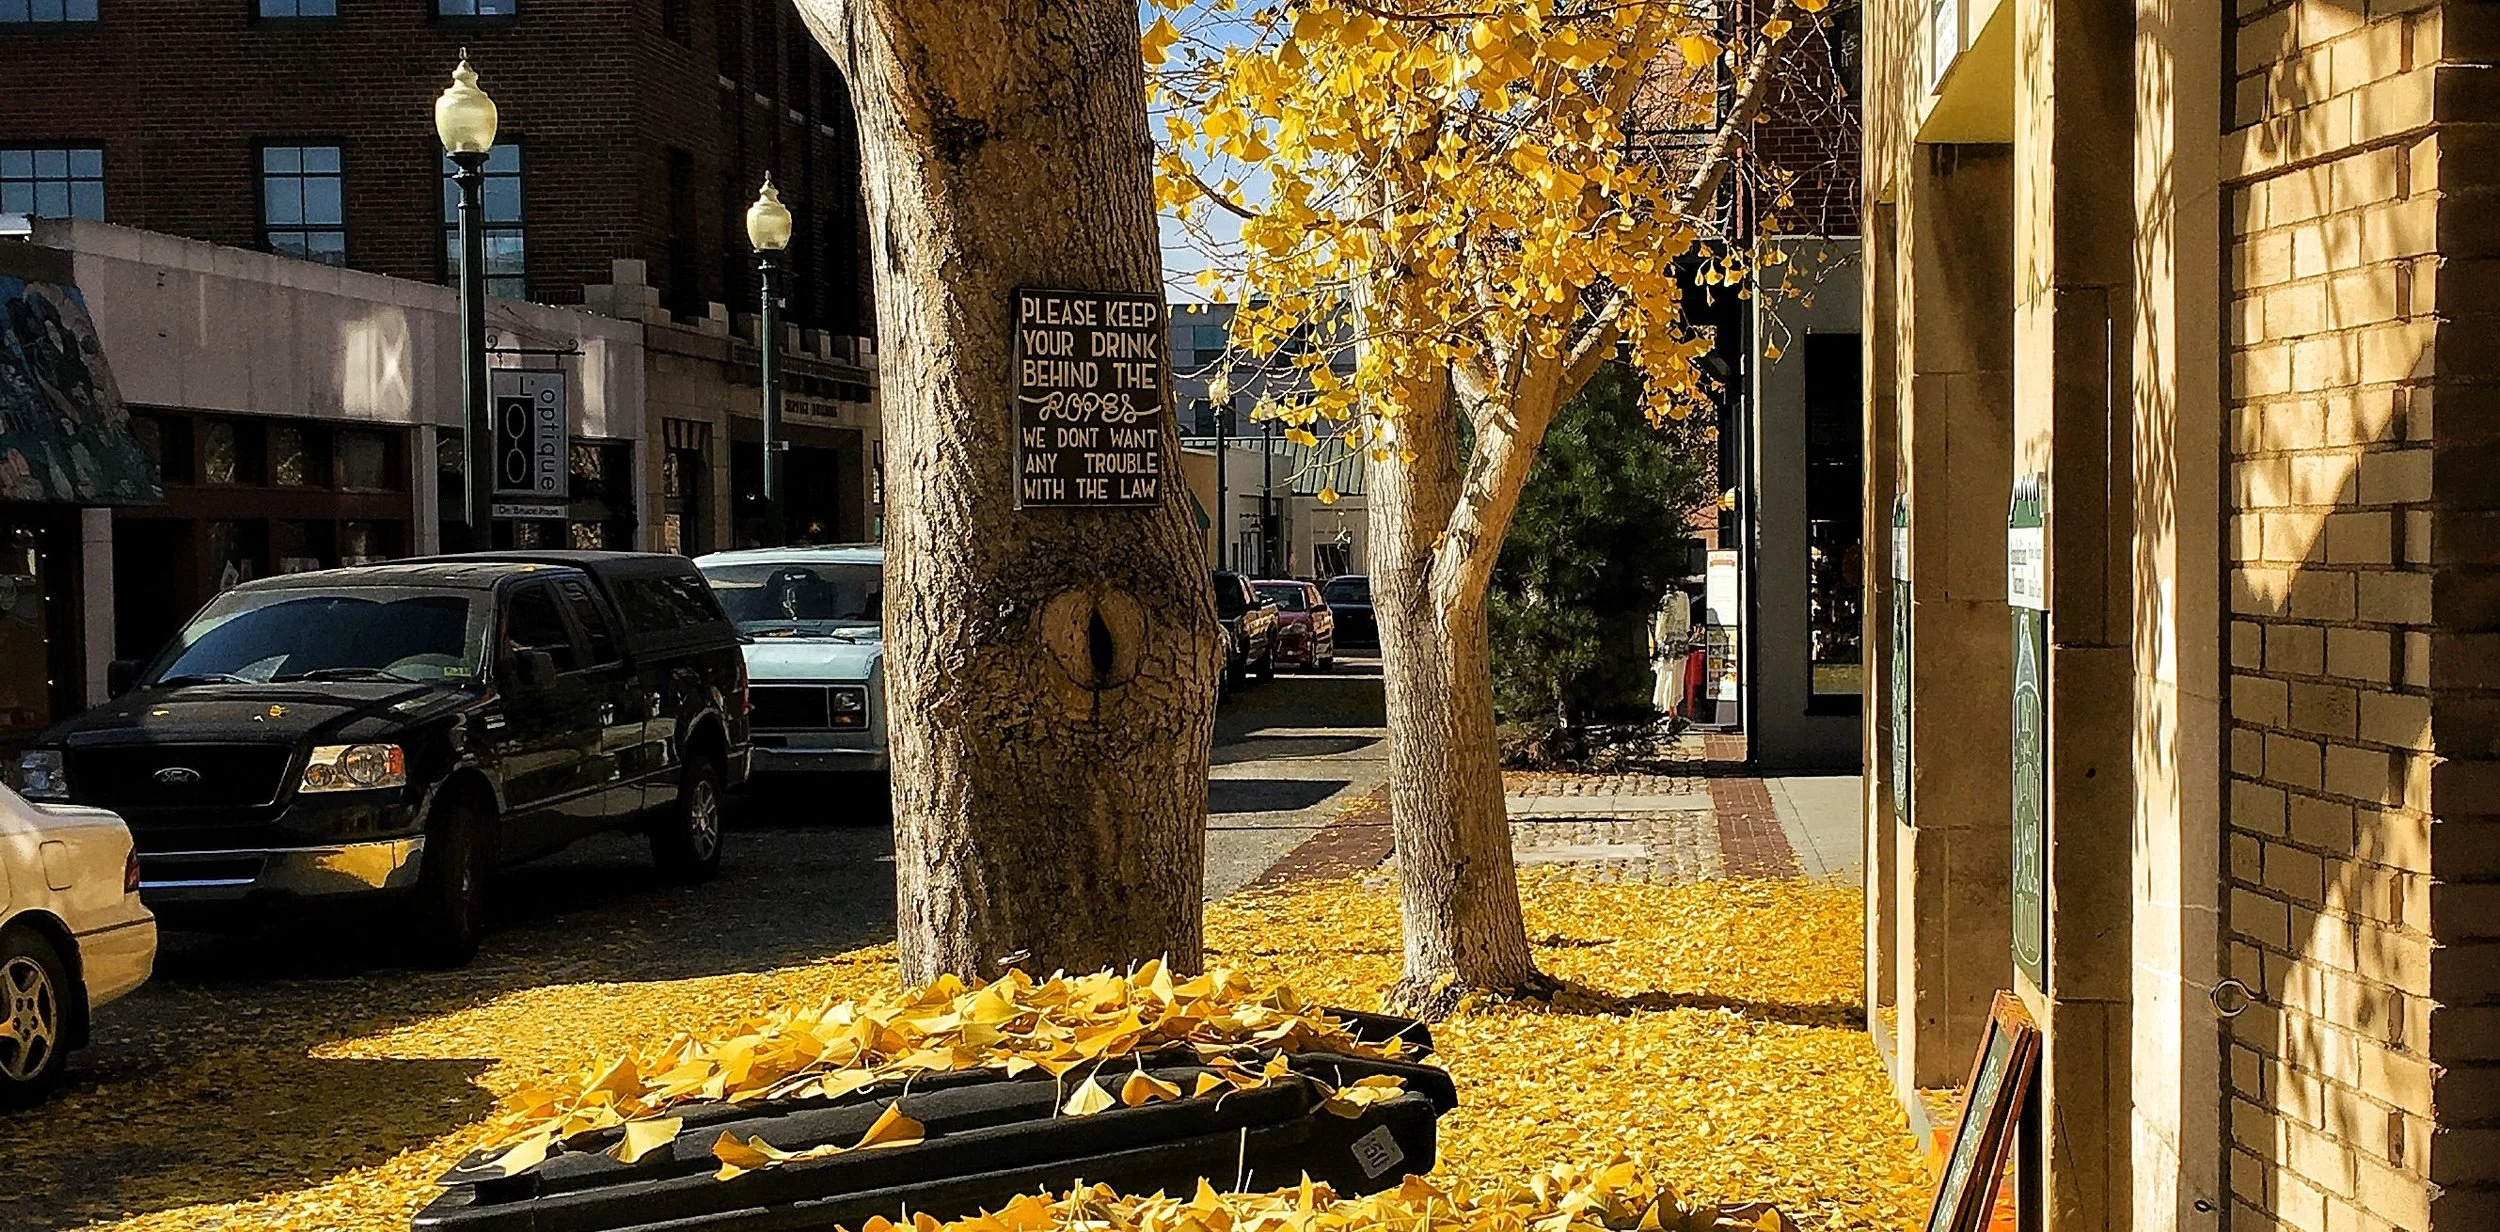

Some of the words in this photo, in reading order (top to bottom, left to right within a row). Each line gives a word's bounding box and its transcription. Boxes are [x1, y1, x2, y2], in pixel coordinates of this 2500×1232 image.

[1022, 297, 1097, 326] PLEASE
[1105, 301, 1157, 327] KEEP
[1022, 330, 1074, 357] YOUR
[1091, 332, 1157, 359] DRINK
[1023, 360, 1098, 388] BEHIND
[1113, 363, 1156, 389] THE
[1019, 391, 1161, 424] ROPES
[1022, 427, 1046, 448] WE
[1057, 427, 1099, 448] DONT
[1110, 428, 1158, 449] WANT
[1025, 453, 1058, 474] ANY
[1084, 452, 1158, 474] TROUBLE
[1024, 478, 1065, 500] WITH
[1075, 478, 1109, 499] THE
[1120, 479, 1156, 499] LAW
